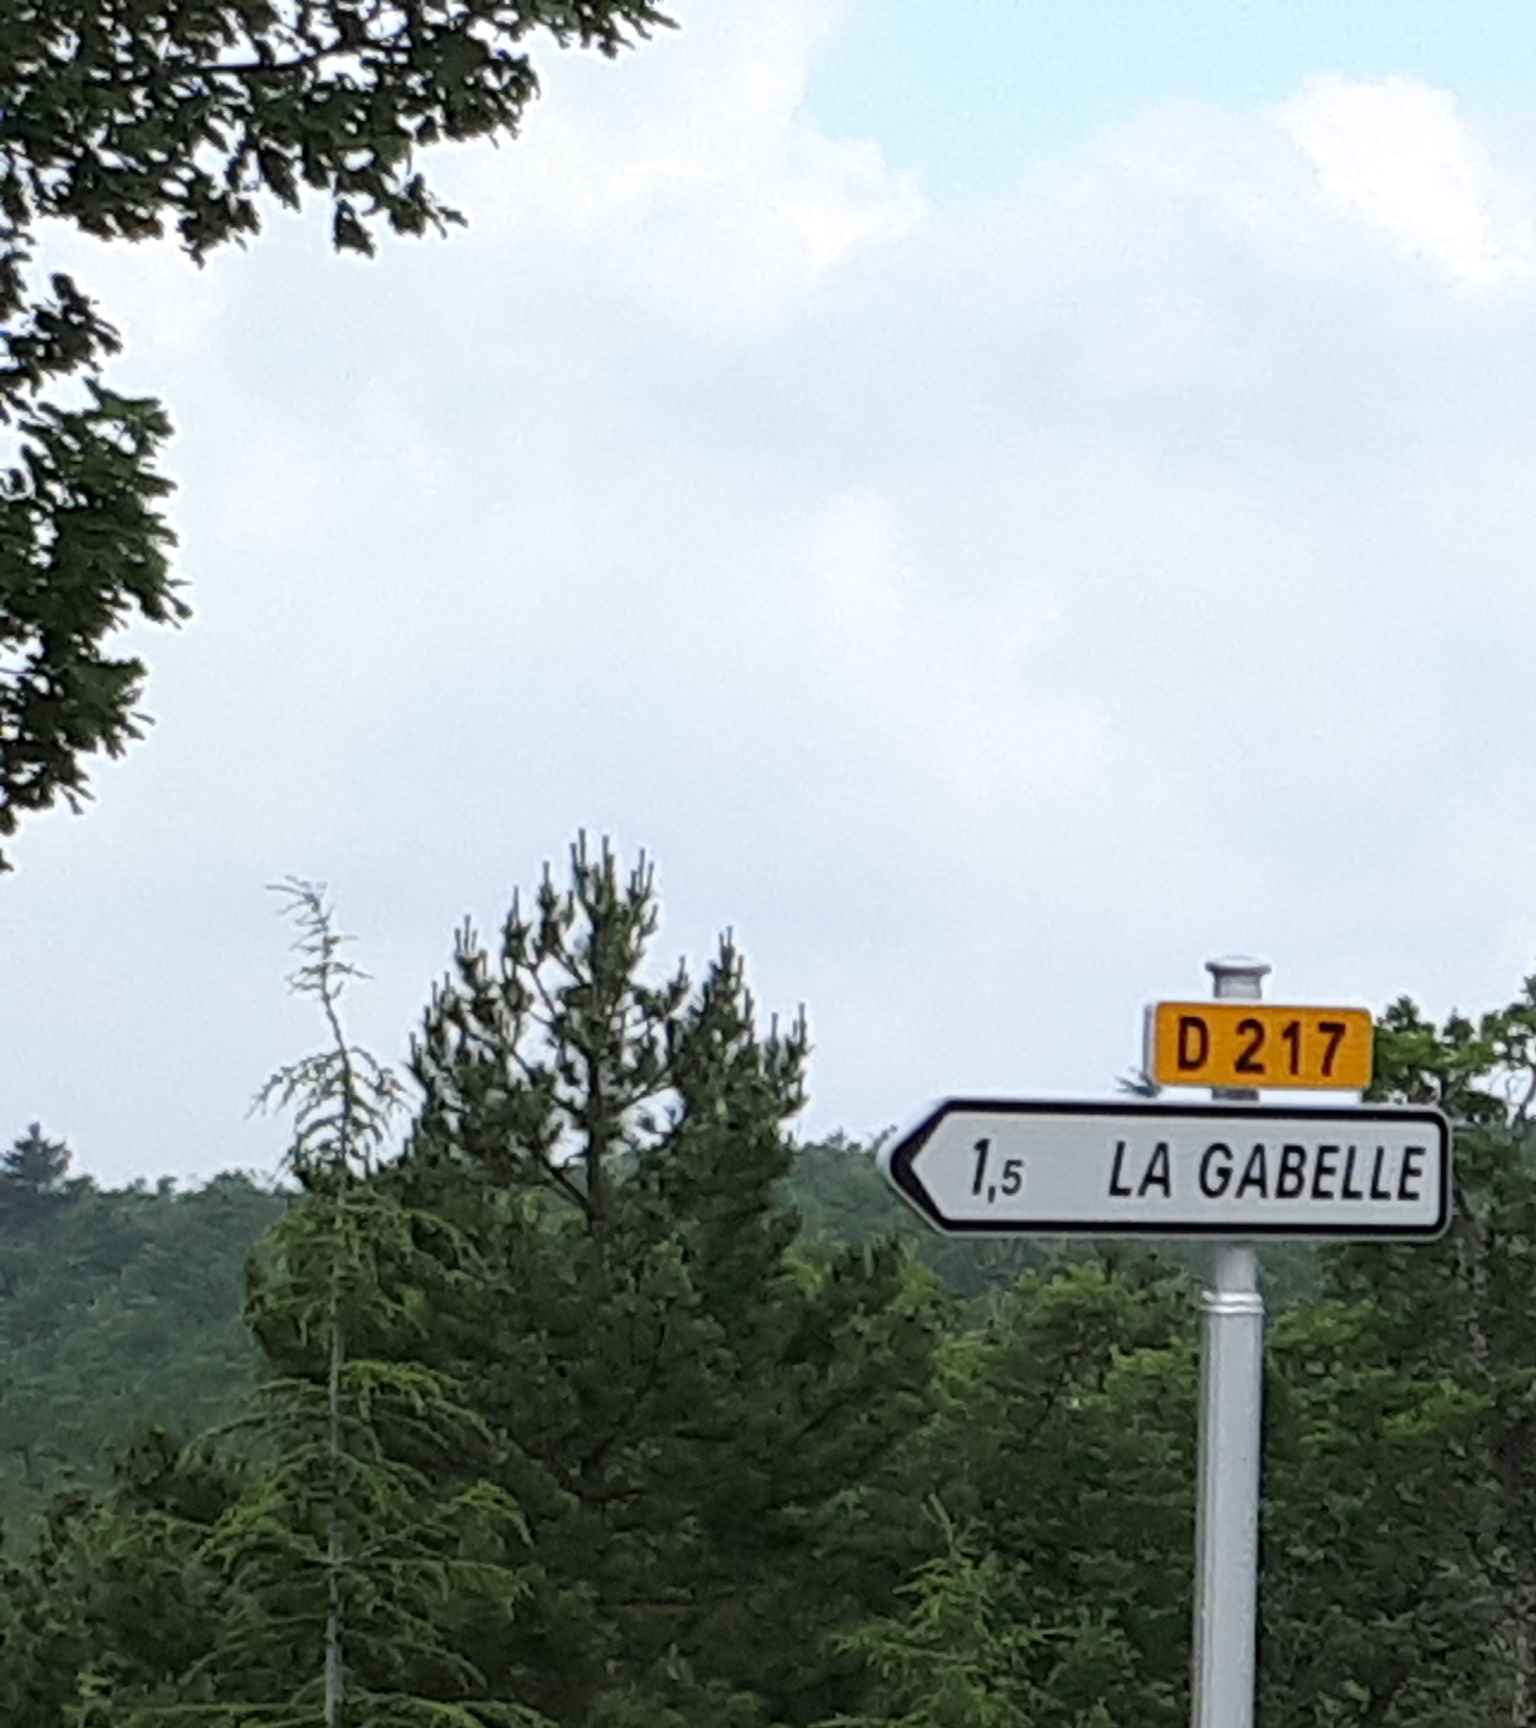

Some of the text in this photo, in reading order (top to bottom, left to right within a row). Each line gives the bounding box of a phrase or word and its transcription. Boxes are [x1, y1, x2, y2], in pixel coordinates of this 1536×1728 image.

[1177, 1015, 1346, 1077] D 217
[972, 1138, 1426, 1204] 1,5 LA GABELLE
